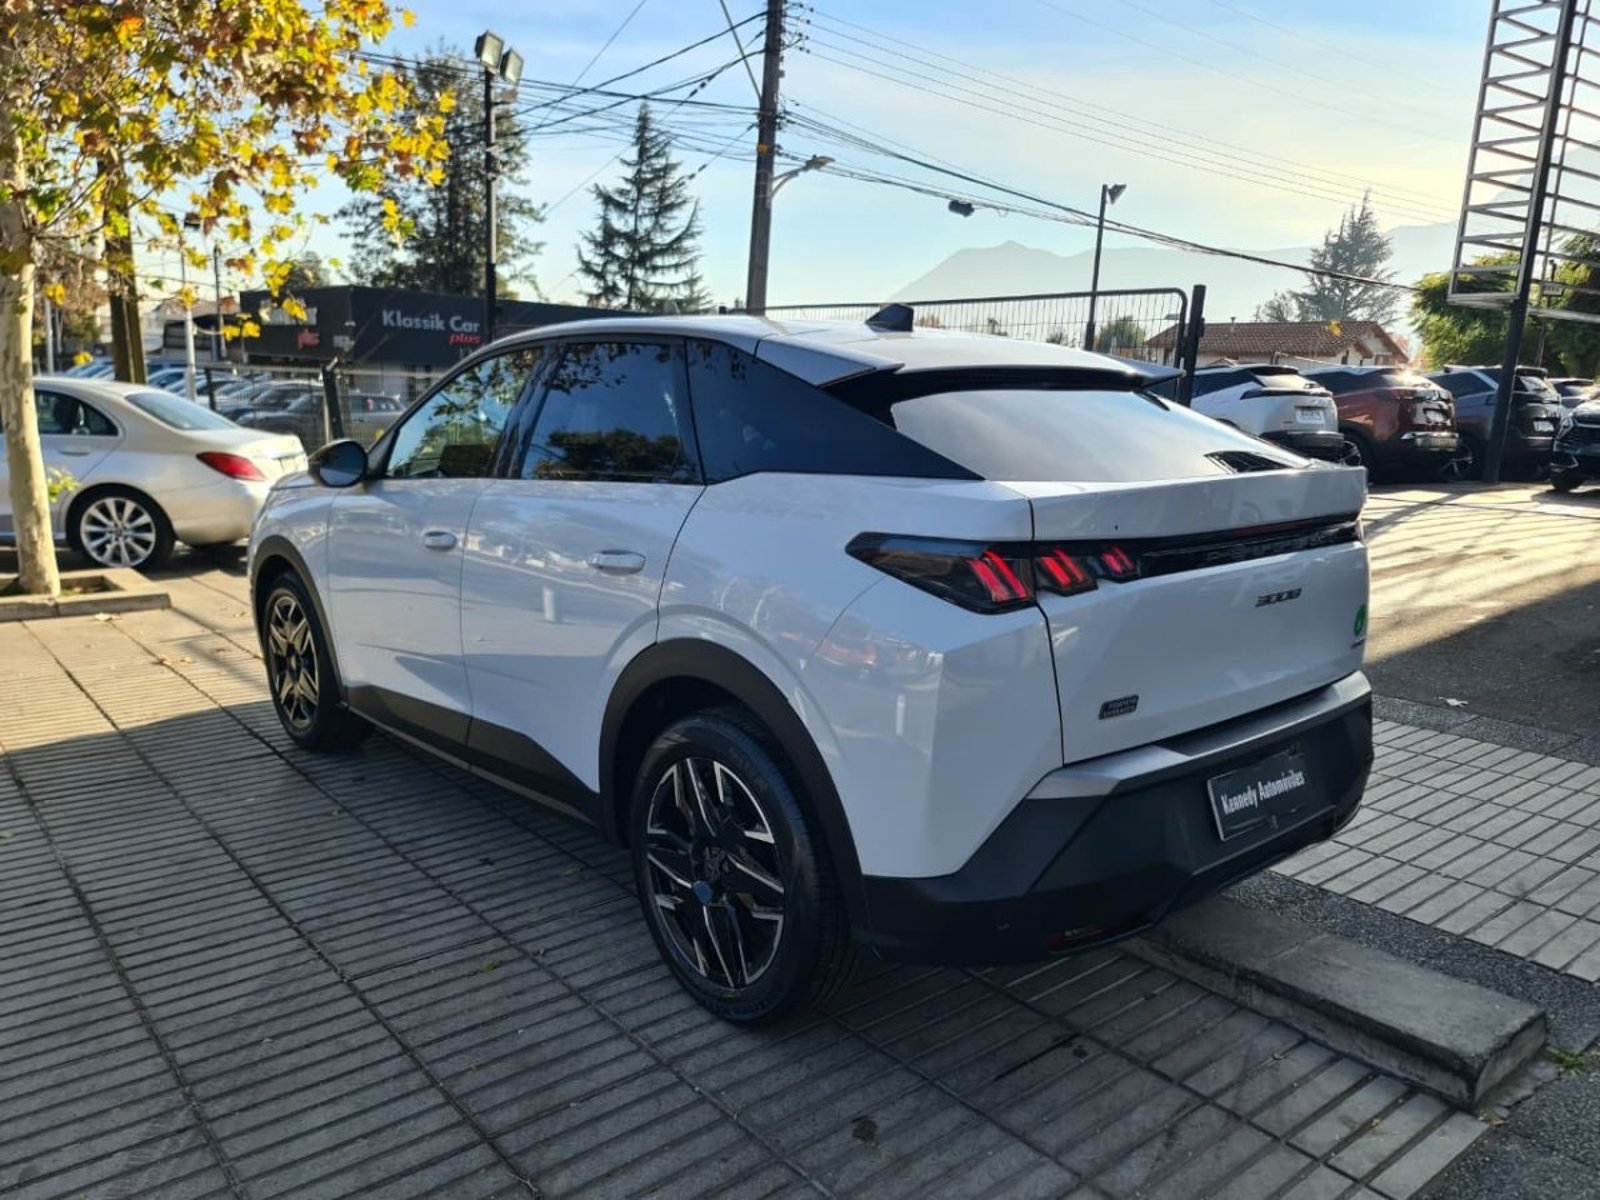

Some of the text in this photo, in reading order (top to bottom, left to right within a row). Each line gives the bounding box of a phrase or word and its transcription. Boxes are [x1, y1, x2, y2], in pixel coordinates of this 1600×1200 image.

[383, 310, 481, 332] Klassik Car
[450, 333, 481, 344] plus
[1221, 785, 1258, 815] Kennedy
